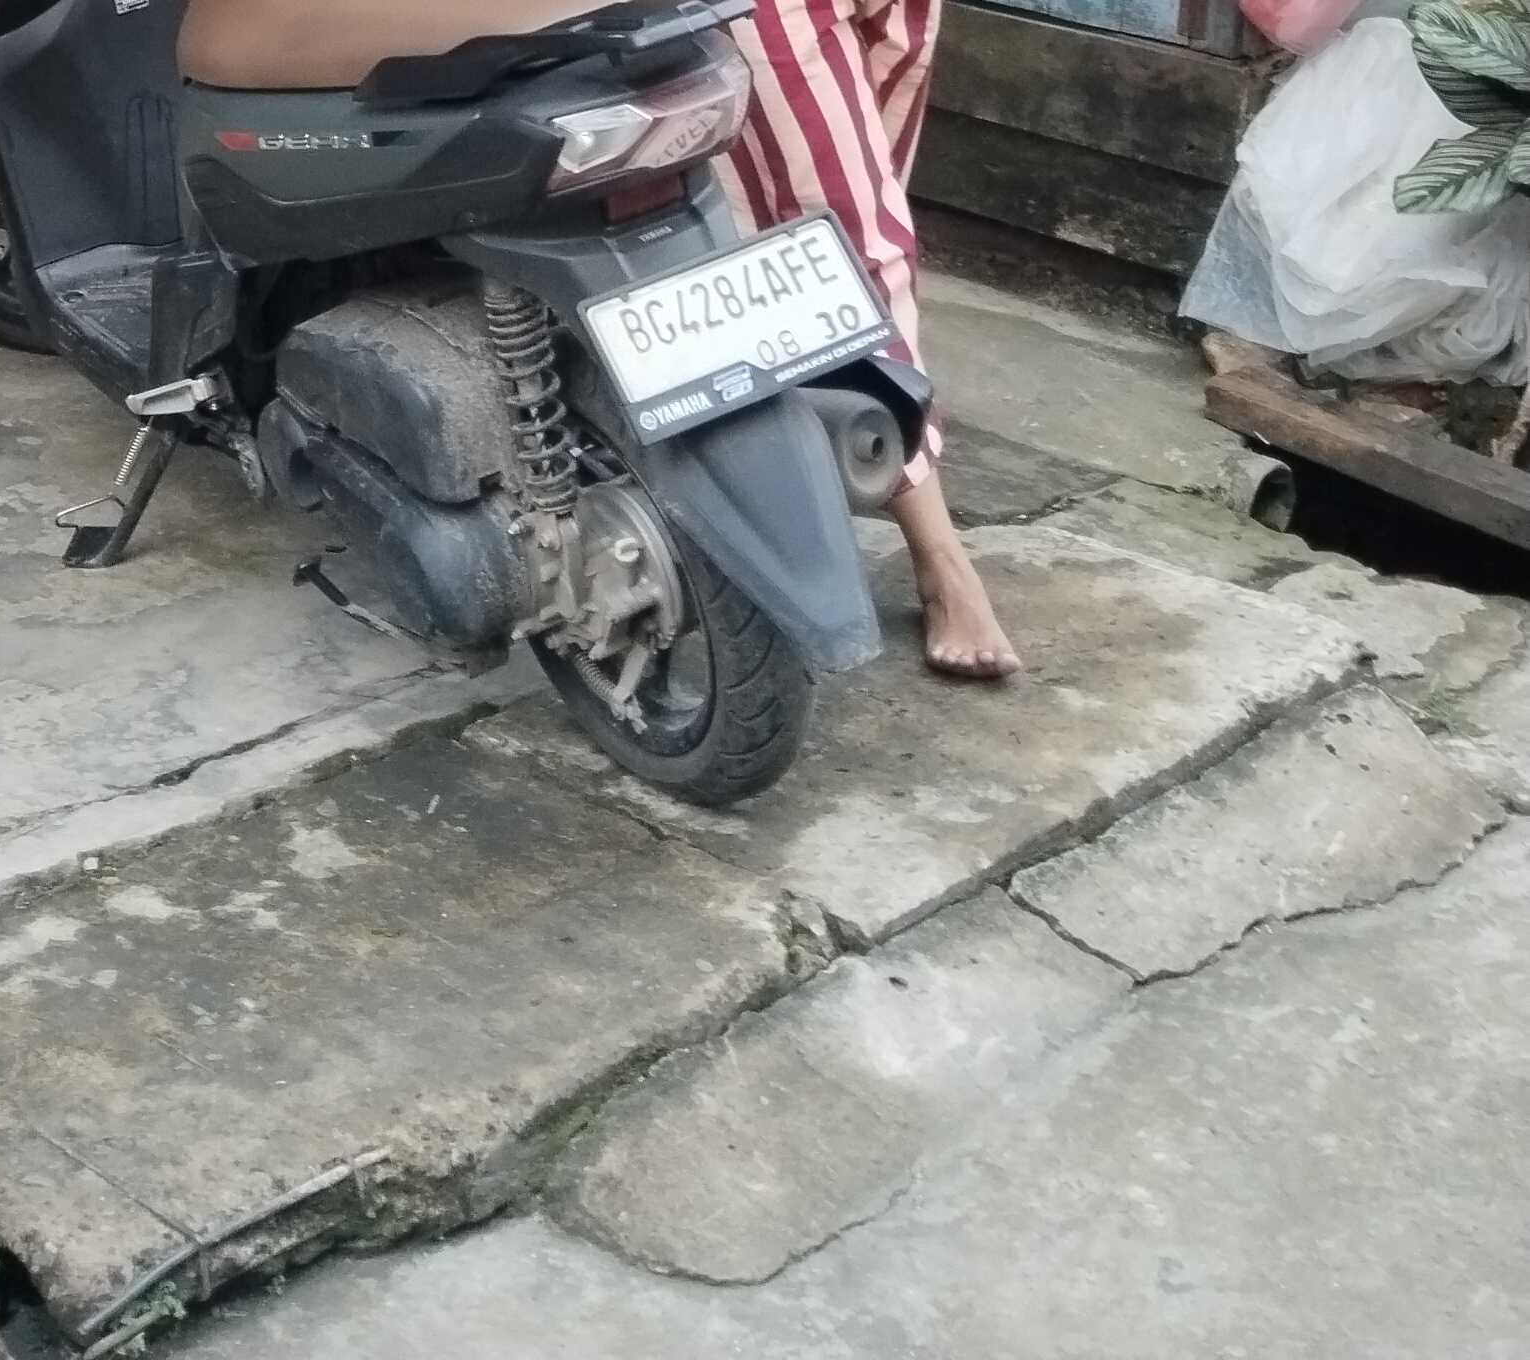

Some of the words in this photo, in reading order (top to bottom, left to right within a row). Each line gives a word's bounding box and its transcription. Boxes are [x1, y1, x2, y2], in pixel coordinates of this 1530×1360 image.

[757, 330, 800, 365] 08
[815, 303, 861, 341] 30
[652, 391, 714, 425] YAMAHA
